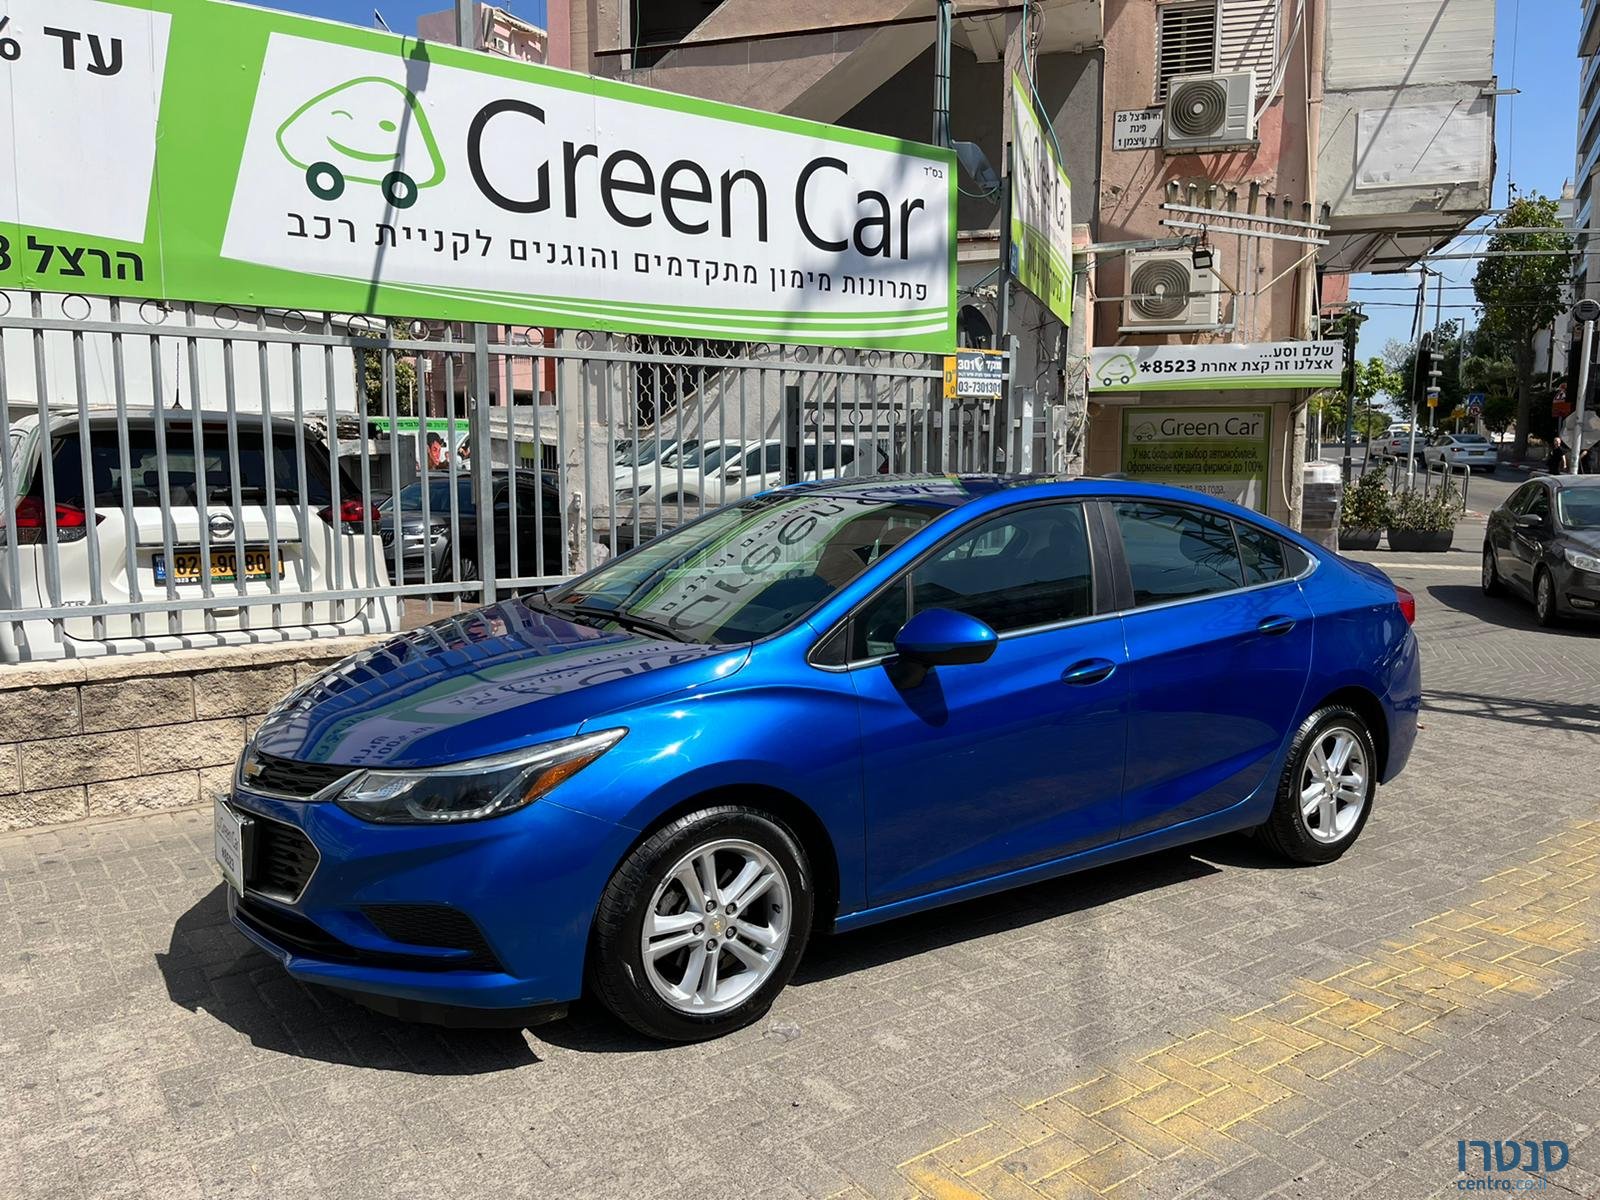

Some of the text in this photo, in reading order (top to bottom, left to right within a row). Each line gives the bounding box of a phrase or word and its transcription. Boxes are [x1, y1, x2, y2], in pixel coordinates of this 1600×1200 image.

[43, 26, 123, 76] עד
[1117, 114, 1127, 122] 28
[1129, 124, 1147, 133] פינת
[467, 98, 925, 260] Green Car
[923, 166, 943, 179] בס"ד
[27, 235, 144, 282] הרצל
[287, 212, 928, 302] פתרונות מימון מתקדמים והוגנים לקניית רכב
[1303, 345, 1334, 356] שלם
[1201, 362, 1237, 372] אחרת
[1241, 361, 1270, 374] קצת
[1275, 361, 1290, 370] זה
[1294, 358, 1333, 370] אצלנו
[1161, 417, 1259, 436] Green Car
